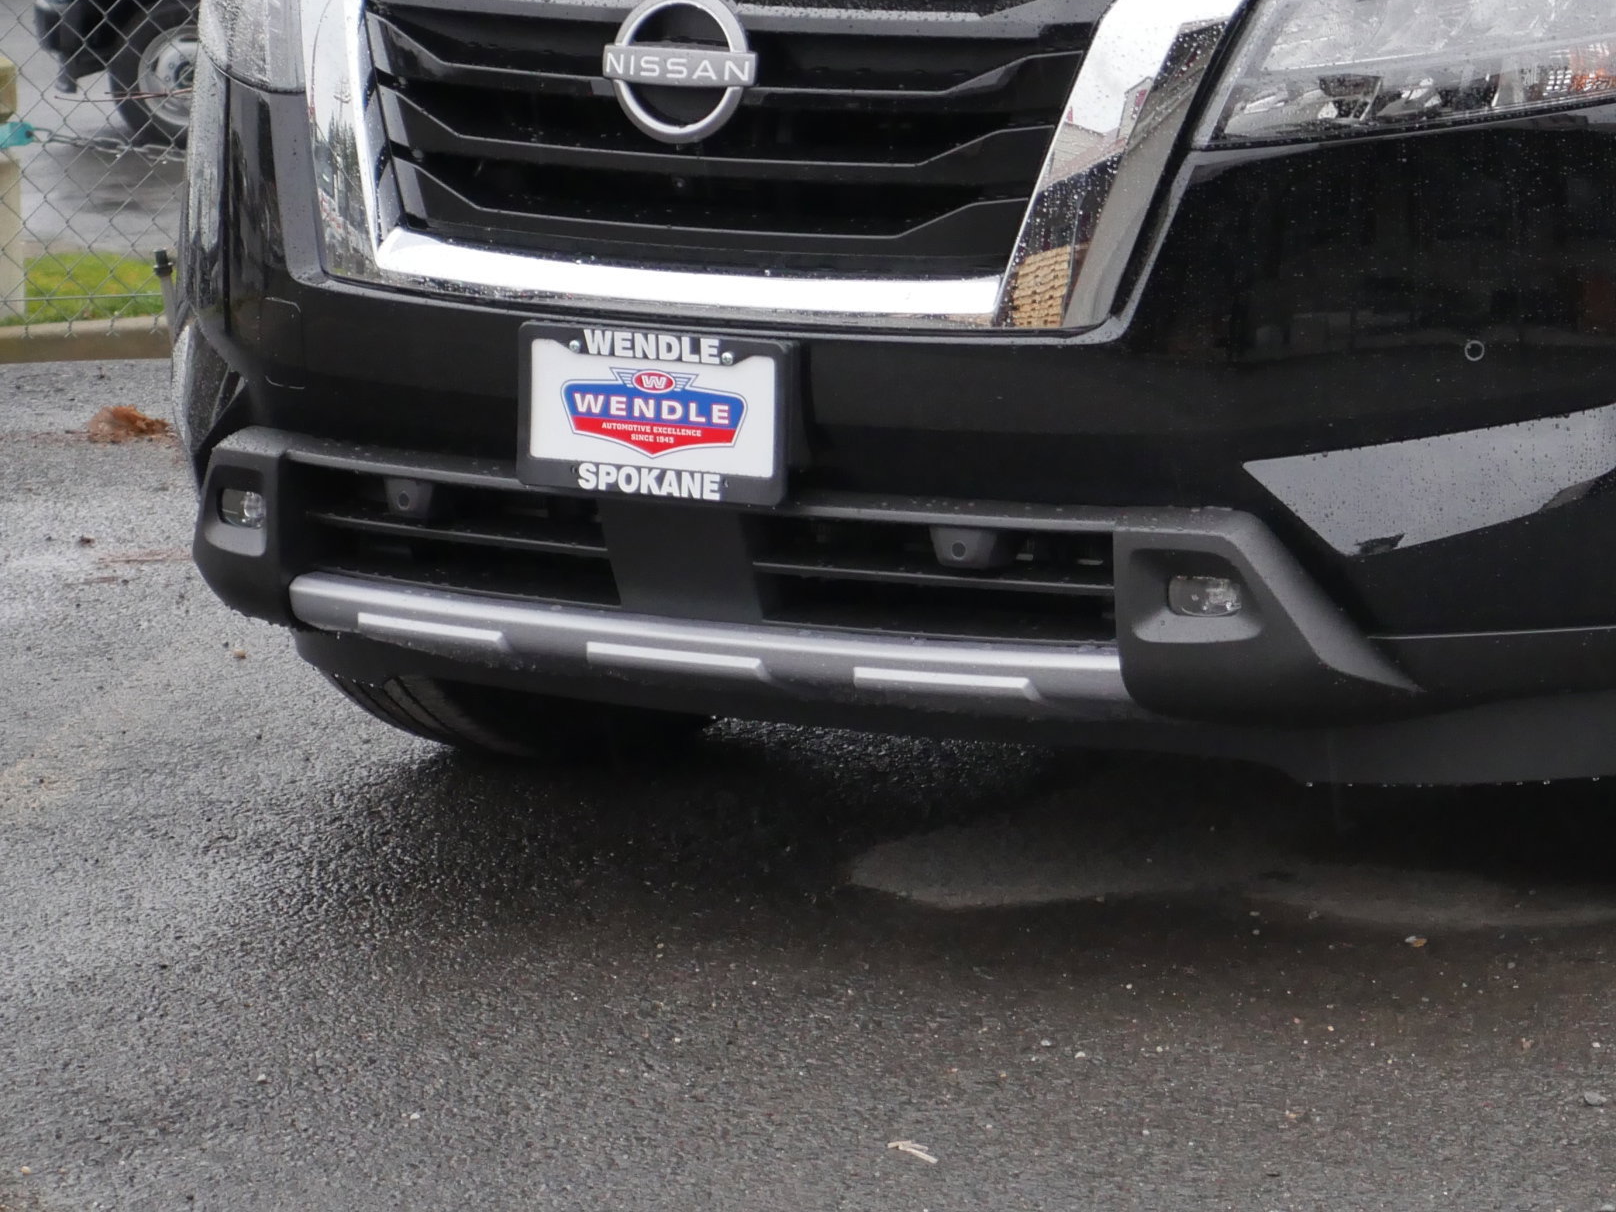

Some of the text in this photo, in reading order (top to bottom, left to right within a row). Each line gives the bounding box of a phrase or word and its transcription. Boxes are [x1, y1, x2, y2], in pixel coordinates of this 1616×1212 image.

[605, 51, 750, 82] NISSAN
[583, 329, 721, 365] WENDLE
[573, 392, 730, 424] WENDLE
[601, 421, 702, 437] AUTOMOTIVE EXCELLENCE
[630, 433, 674, 444] SINCE 1943
[577, 462, 721, 501] SPOKANE
